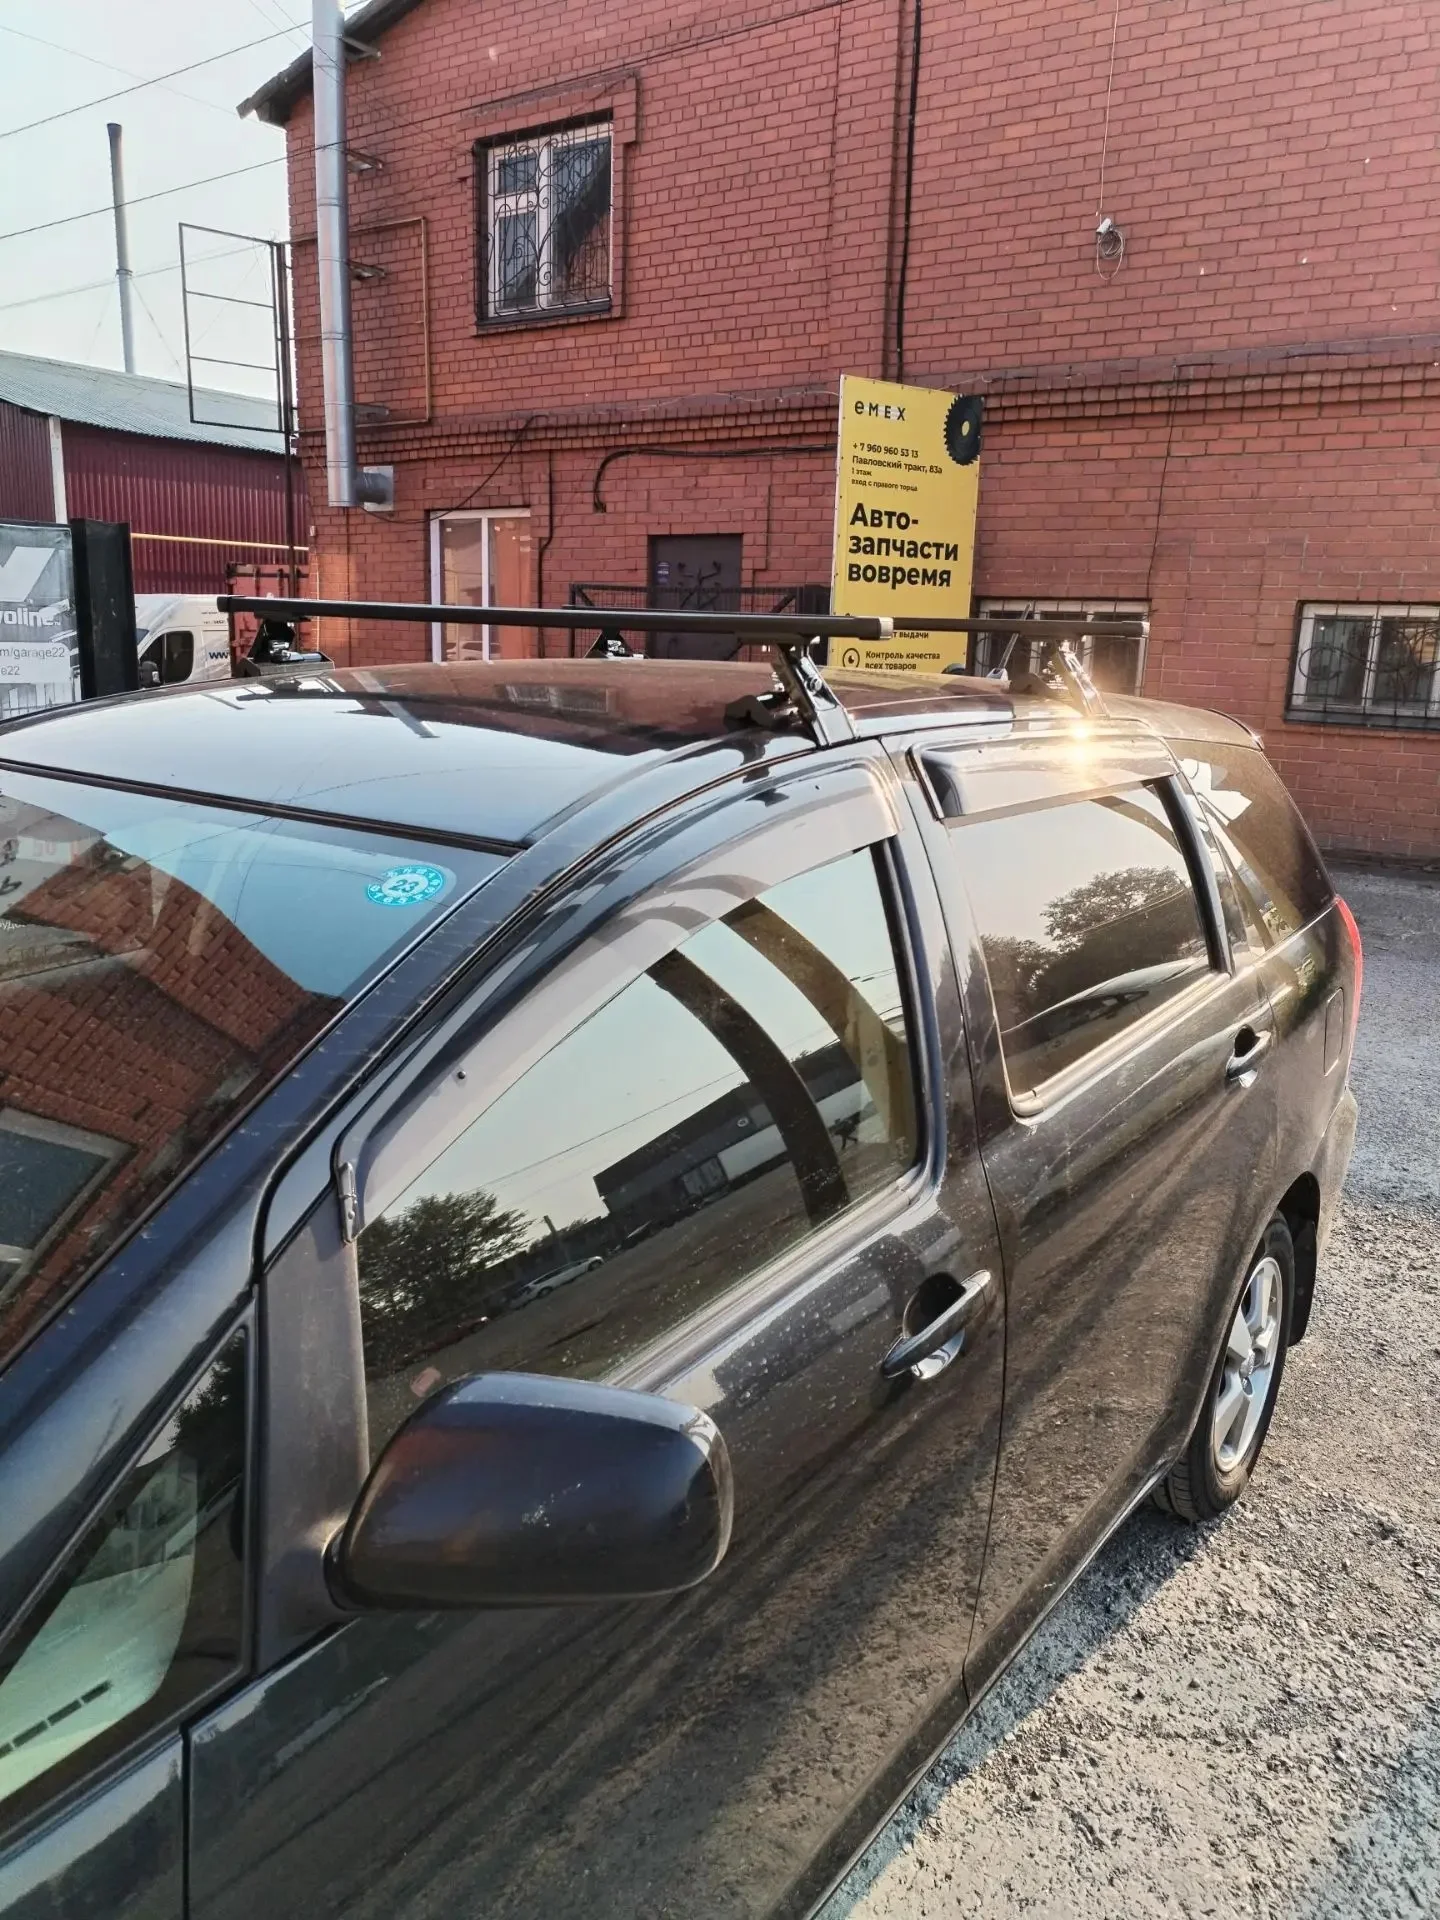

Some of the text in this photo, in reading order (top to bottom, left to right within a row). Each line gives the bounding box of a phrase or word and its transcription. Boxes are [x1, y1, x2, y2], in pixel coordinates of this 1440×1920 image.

[866, 443, 882, 453] 960
[884, 446, 898, 457] 960
[900, 448, 910, 457] 53
[911, 449, 919, 459] 13
[852, 455, 902, 469] Павловский
[856, 468, 872, 477] этаж
[851, 478, 867, 487] вход
[873, 481, 899, 490] правого
[850, 502, 919, 530] Авто-
[848, 535, 959, 561] запчасти
[848, 563, 951, 589] вовремя
[899, 631, 929, 640] выдачи
[865, 650, 941, 661] Контроль качества
[865, 662, 917, 672] всех товаров
